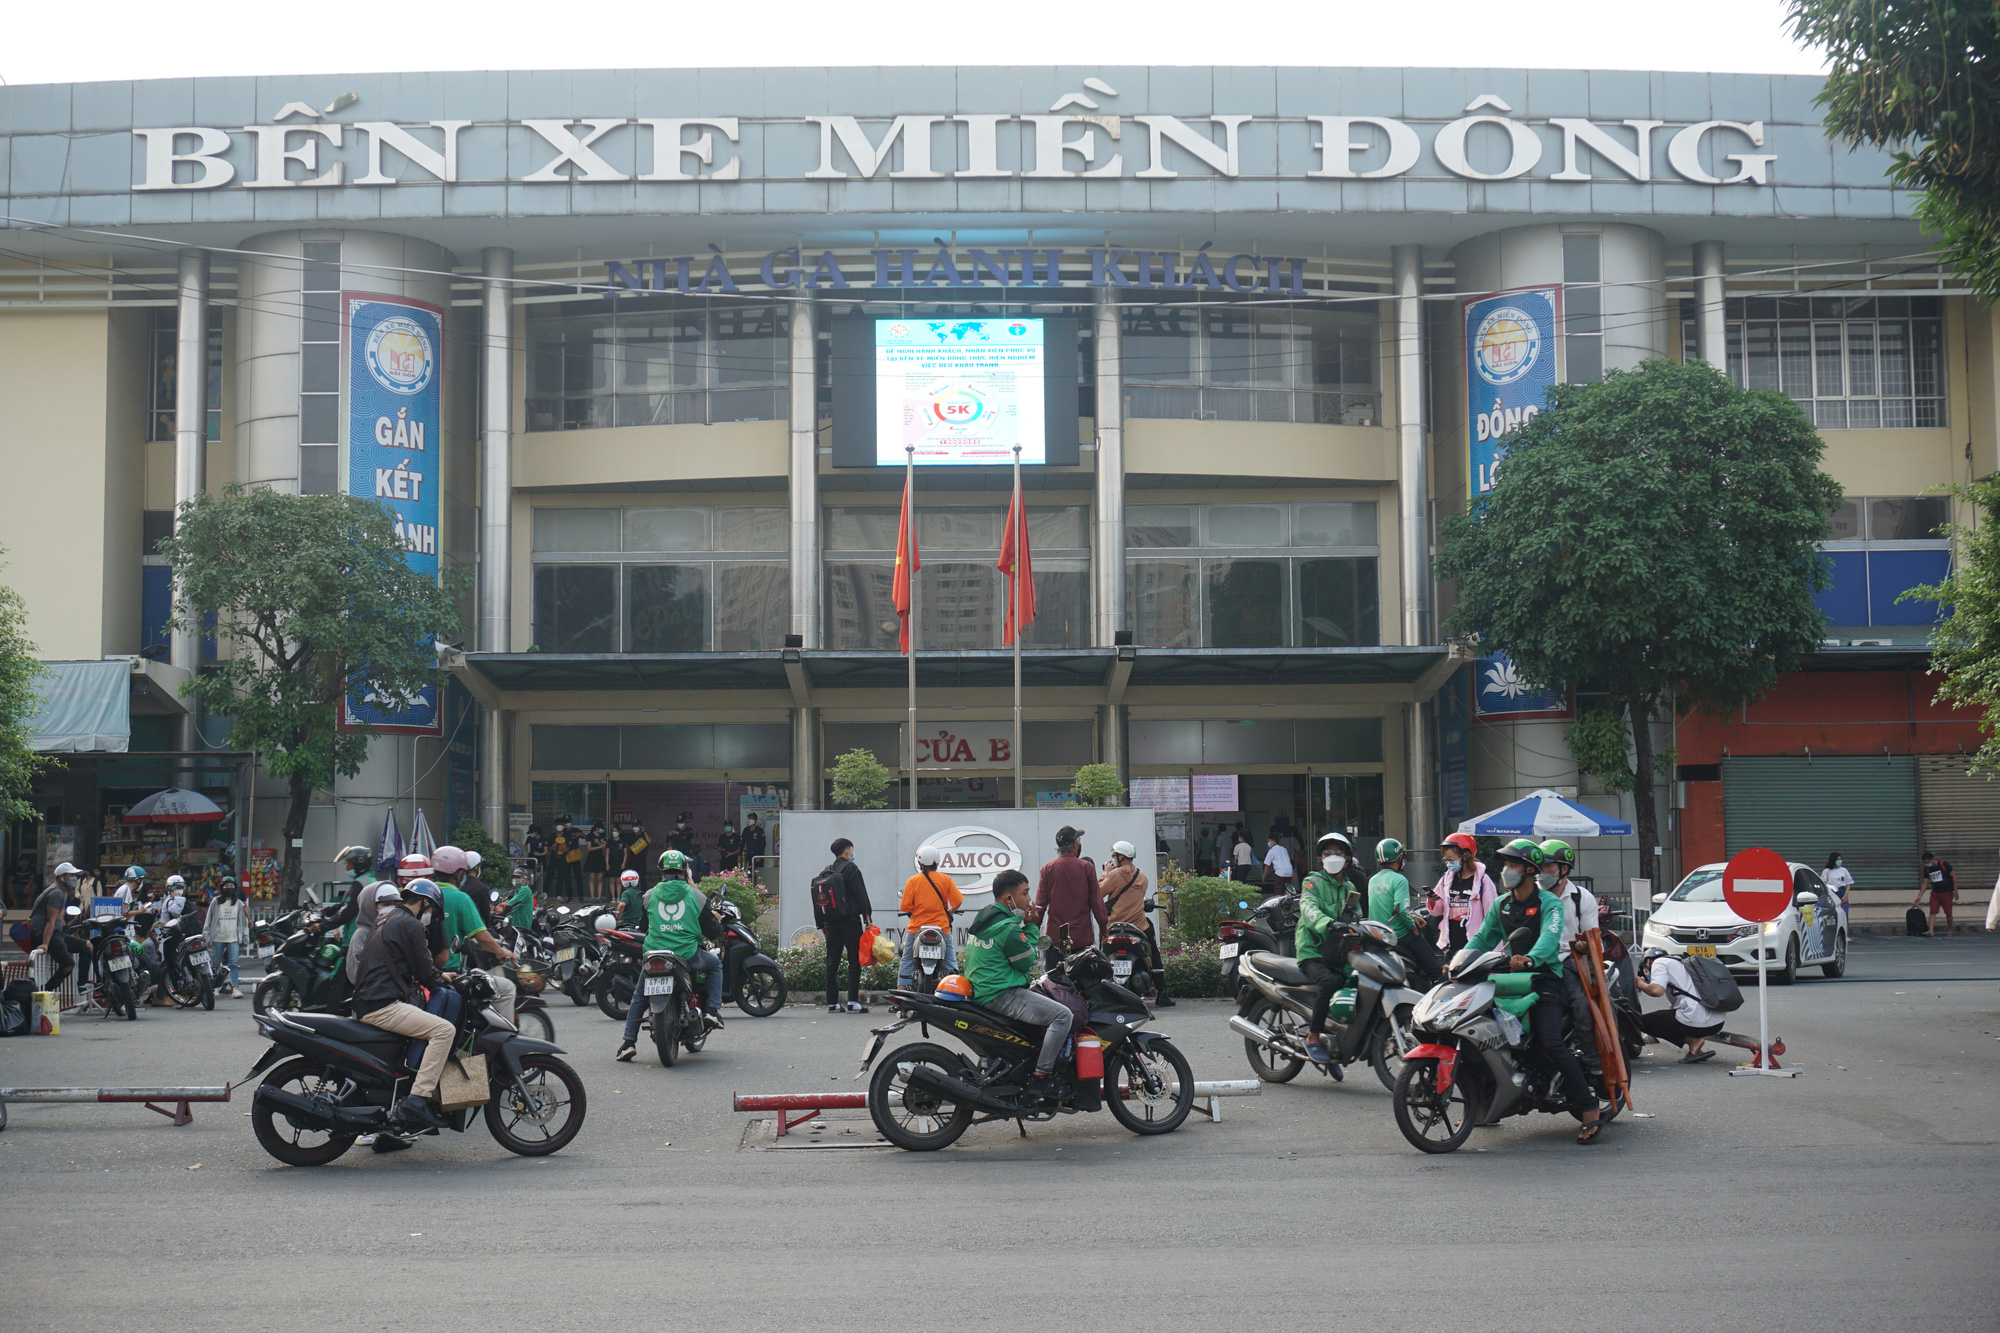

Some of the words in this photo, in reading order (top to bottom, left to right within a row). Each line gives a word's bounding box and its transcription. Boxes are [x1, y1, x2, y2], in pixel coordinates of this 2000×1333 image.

[131, 91, 473, 191] BẾN
[520, 117, 741, 183] XE
[804, 77, 1253, 179] MIỀN
[1306, 94, 1778, 186] ĐÔNG
[603, 242, 740, 298] NHÀ
[760, 249, 850, 289] GA
[870, 237, 1065, 288] HÀNH
[1086, 240, 1308, 295] KHÁCH
[946, 405, 970, 414] 5K
[374, 407, 426, 451] GẮN
[375, 458, 425, 502] KẾT
[385, 513, 436, 556] ÀNH
[916, 730, 976, 762] CỬA
[988, 738, 1011, 762] B
[613, 813, 632, 822] ATM
[937, 852, 1011, 868] AMCO
[659, 923, 684, 932] gojek
[646, 985, 672, 995] 186.48
[968, 1023, 1036, 1049] EXCITE
